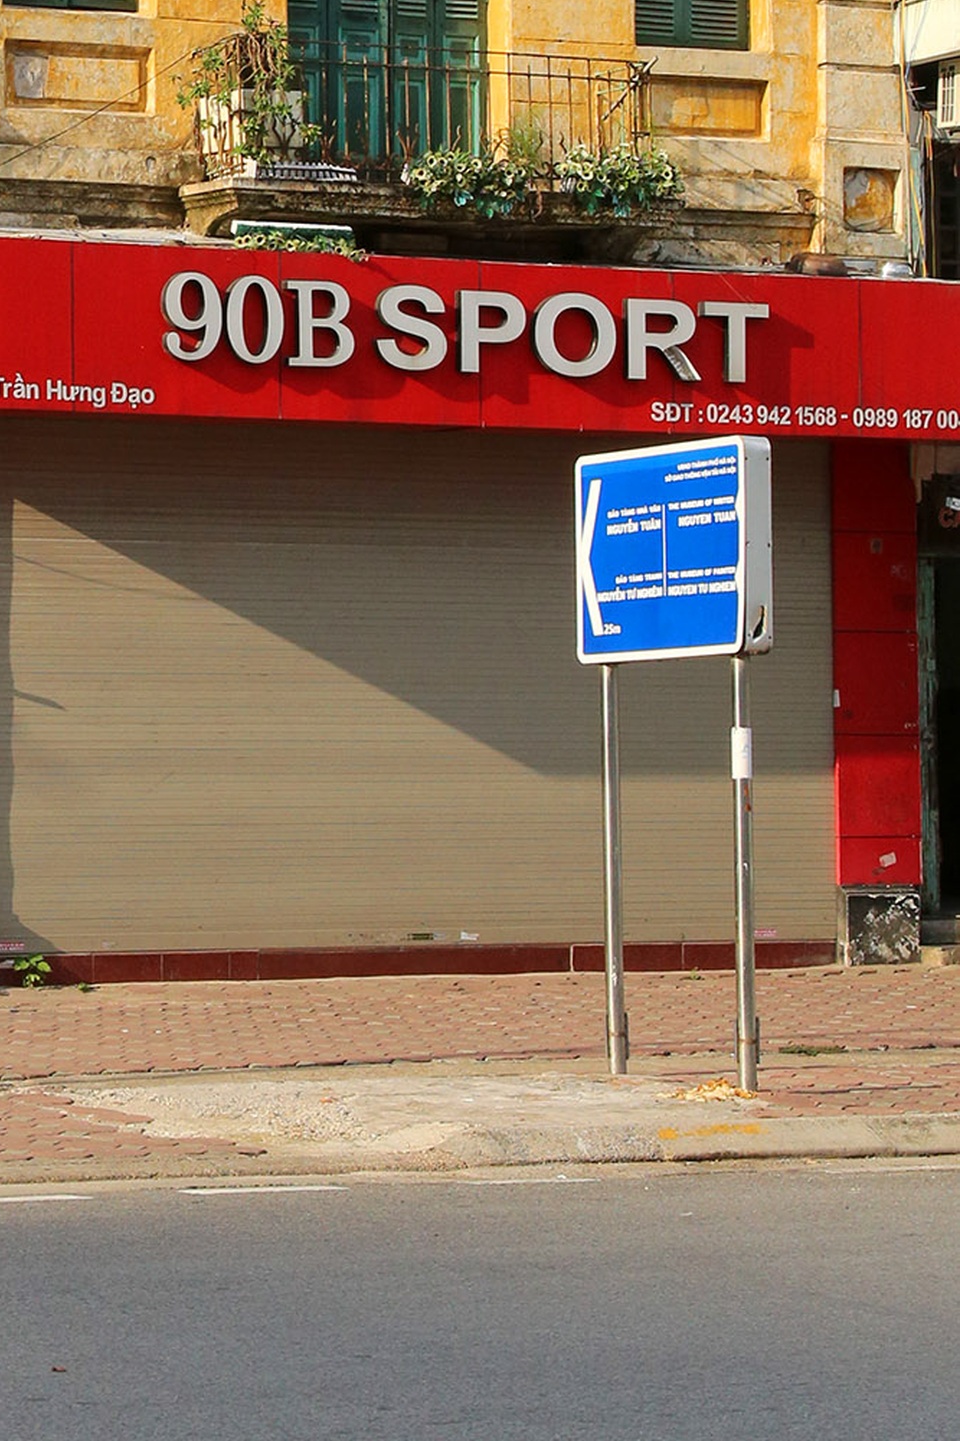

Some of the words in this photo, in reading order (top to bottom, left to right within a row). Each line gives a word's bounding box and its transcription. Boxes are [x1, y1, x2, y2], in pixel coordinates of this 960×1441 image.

[161, 271, 355, 366] 90B
[375, 284, 770, 383] SPORT
[46, 379, 106, 408] Hưng
[110, 382, 155, 408] Đạo
[757, 405, 791, 425] 942
[795, 406, 837, 426] 1568
[852, 407, 898, 428] 0989
[902, 409, 933, 429] 187
[936, 409, 960, 429] 00
